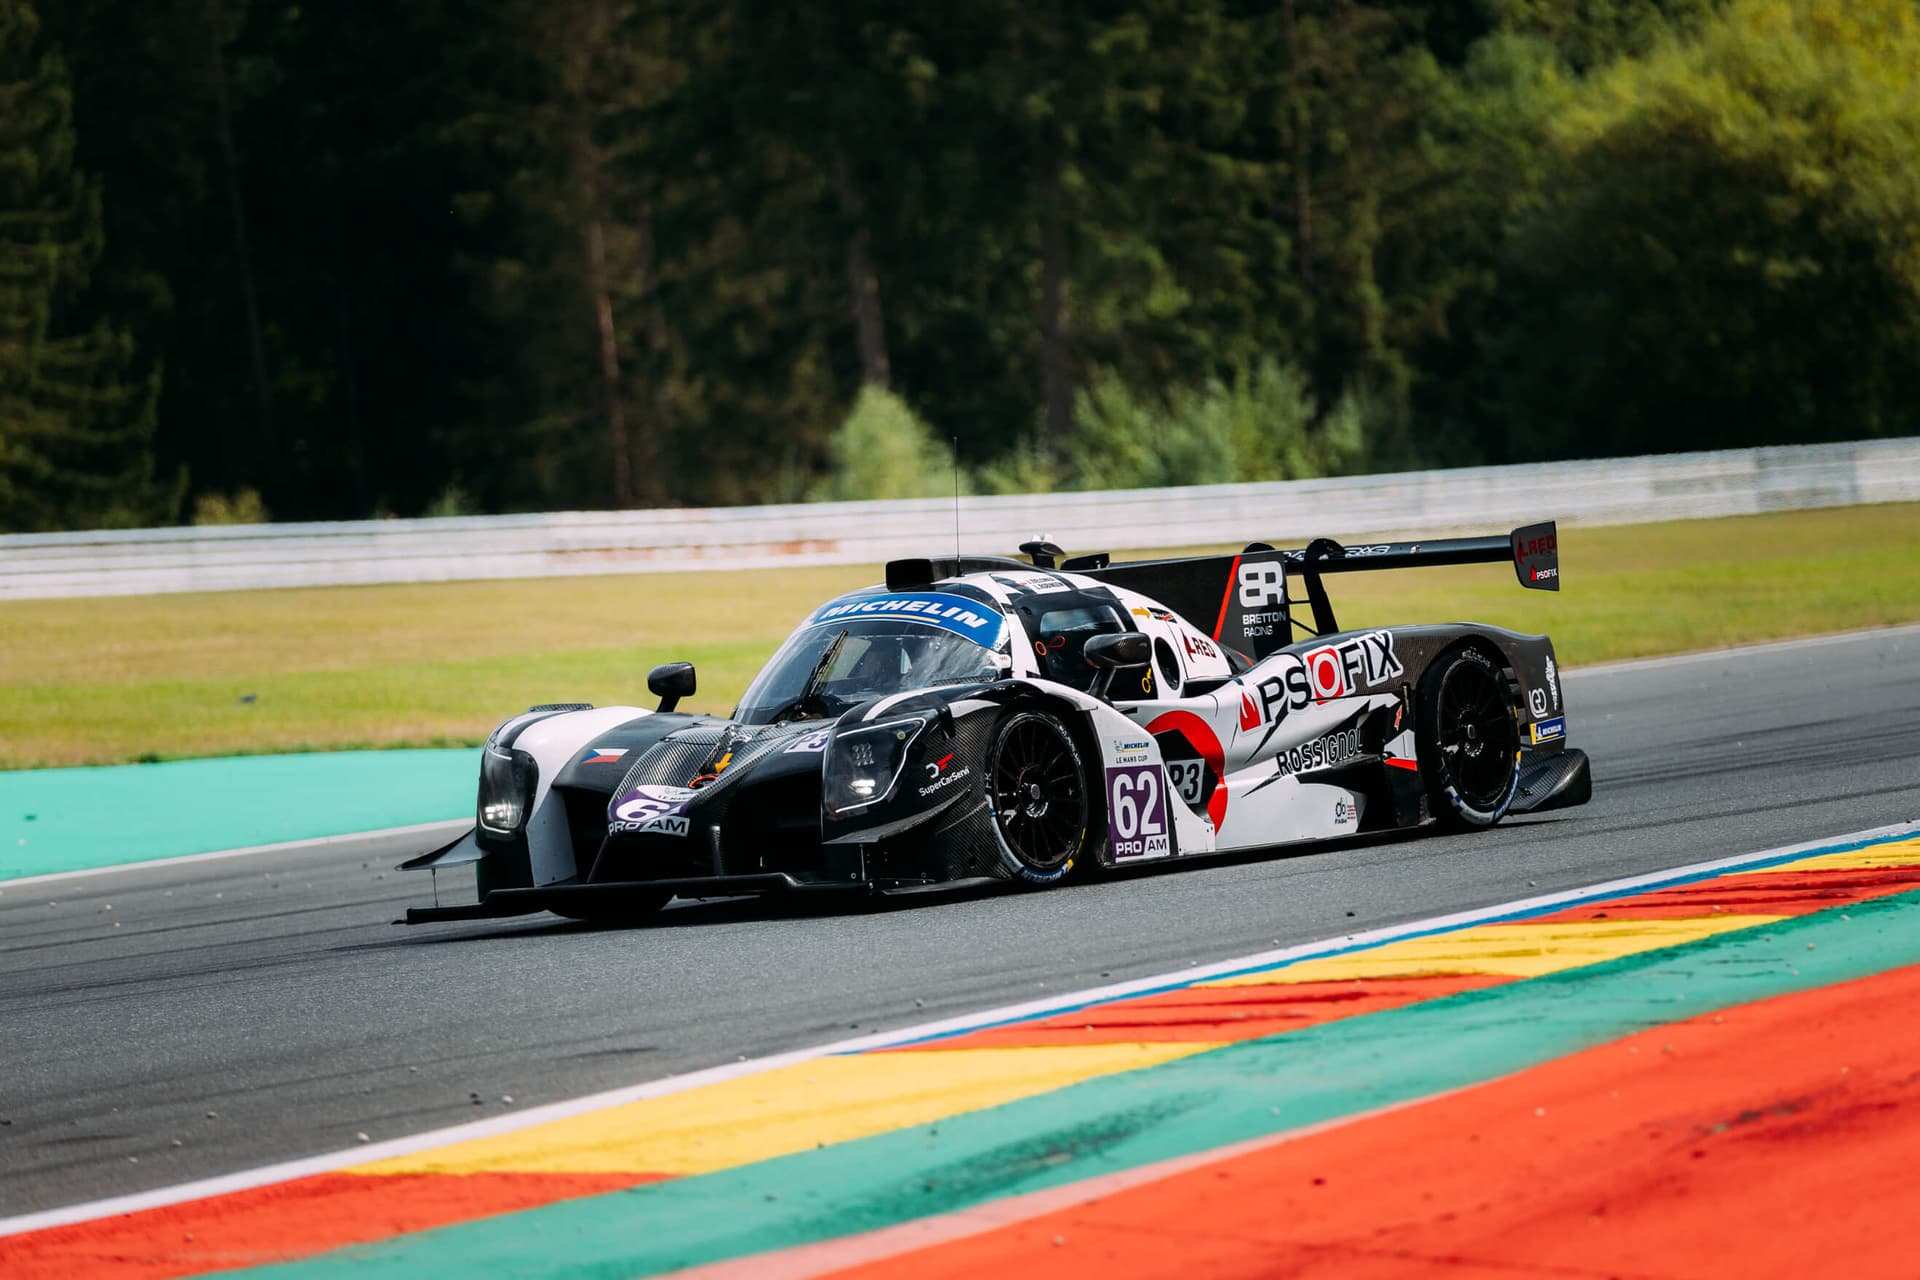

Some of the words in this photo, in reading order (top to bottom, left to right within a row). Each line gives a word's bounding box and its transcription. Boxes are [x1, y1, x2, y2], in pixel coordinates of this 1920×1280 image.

[820, 600, 988, 629] MICHELIN
[1242, 611, 1286, 625] BRETTON
[1243, 625, 1273, 637] RACING
[1257, 632, 1401, 724] PSOFIX
[1123, 742, 1149, 750] MICHELIN
[1169, 763, 1200, 800] P3
[1113, 771, 1162, 839] 62
[608, 821, 640, 837] PRO
[648, 818, 687, 834] AM
[1116, 841, 1142, 855] PRO
[1147, 838, 1167, 852] AM
